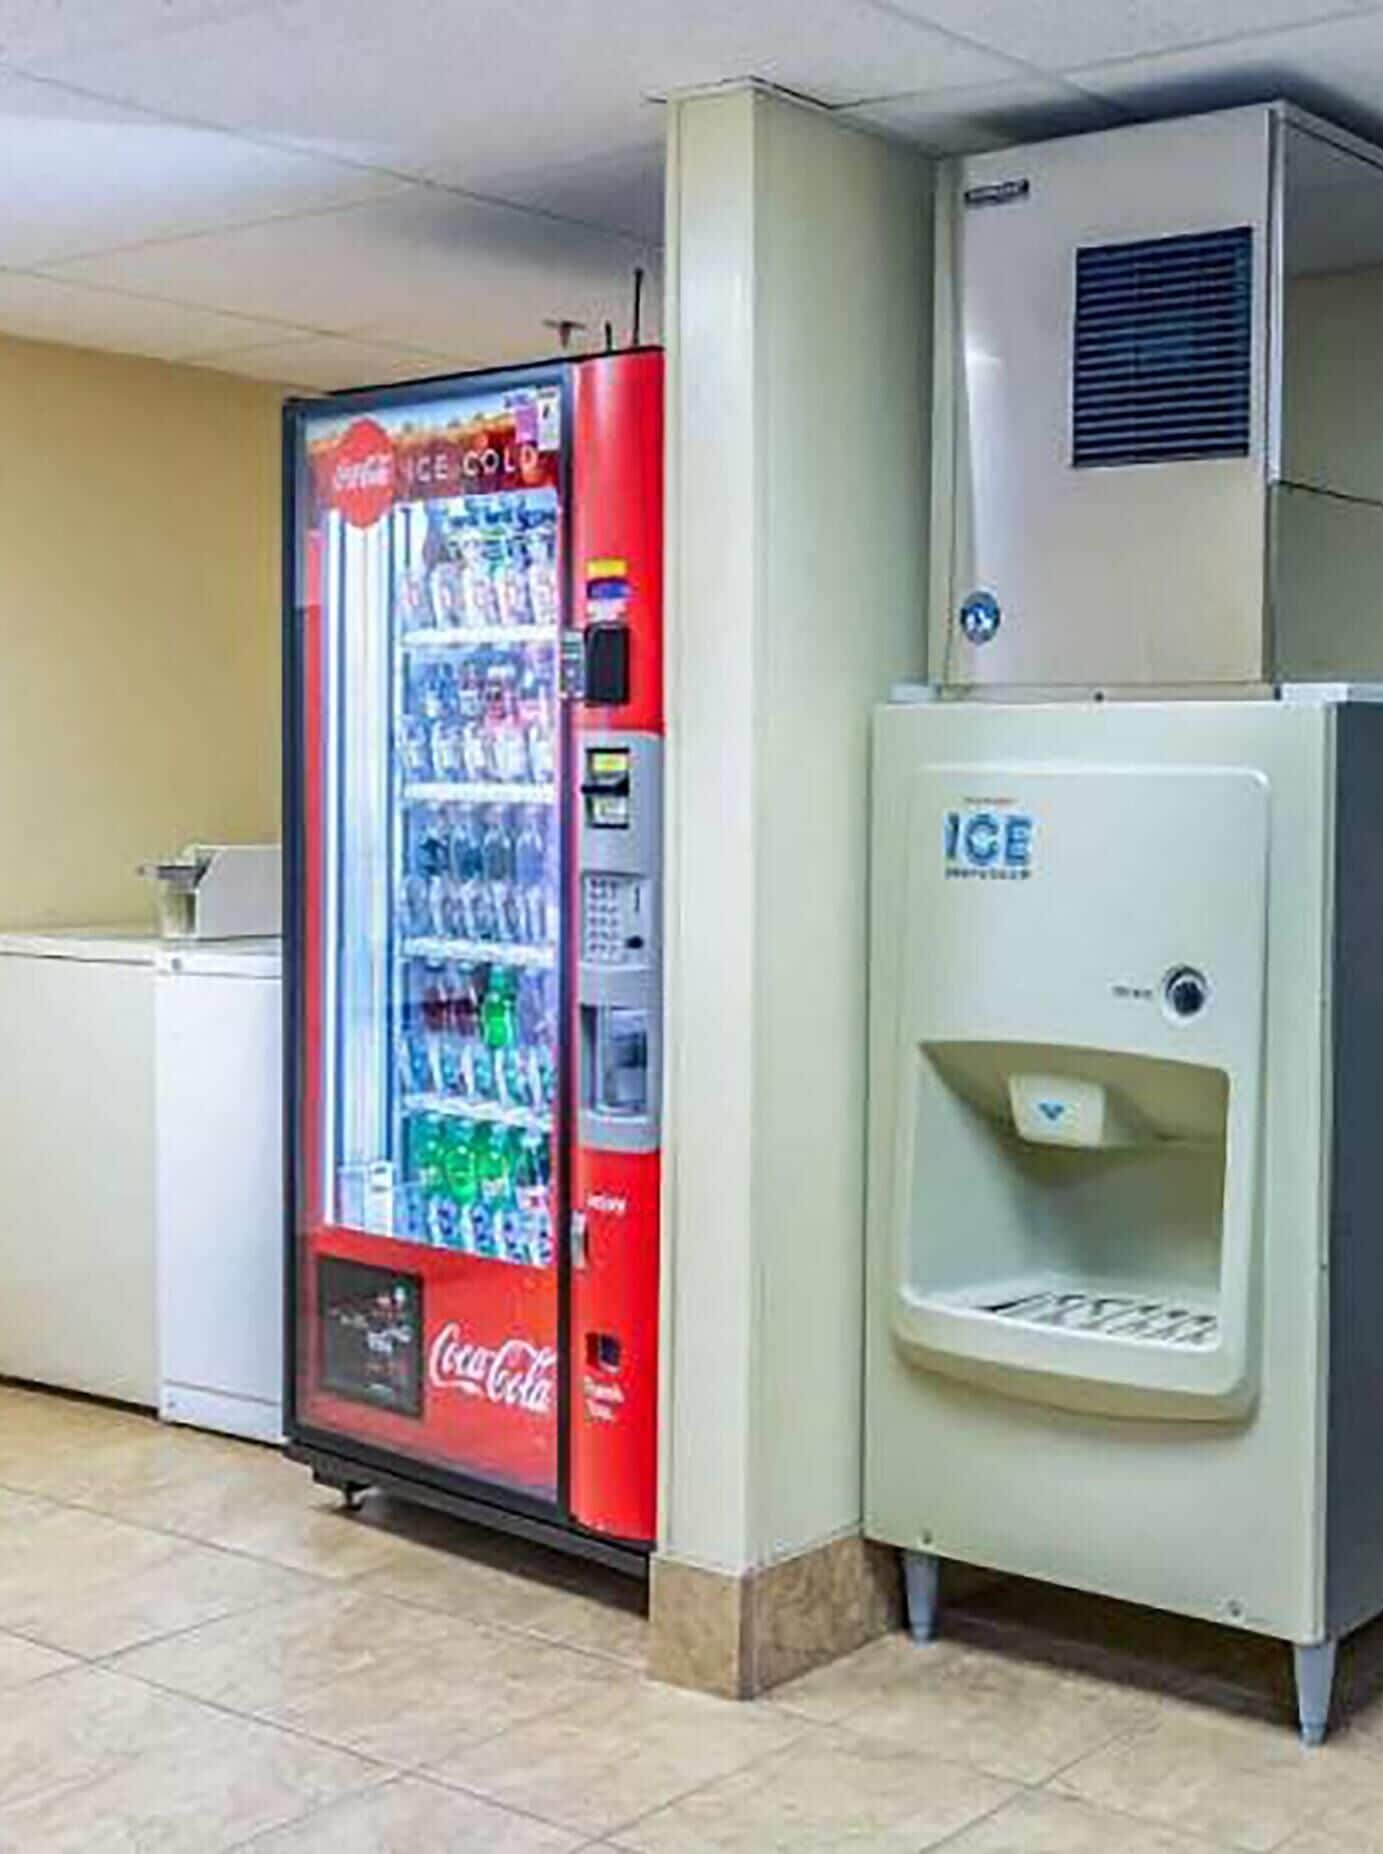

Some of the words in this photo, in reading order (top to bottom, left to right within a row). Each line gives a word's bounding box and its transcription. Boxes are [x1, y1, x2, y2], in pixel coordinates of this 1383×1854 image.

[406, 454, 448, 482] ICE
[463, 445, 538, 476] COLD
[944, 812, 1032, 866] ICE
